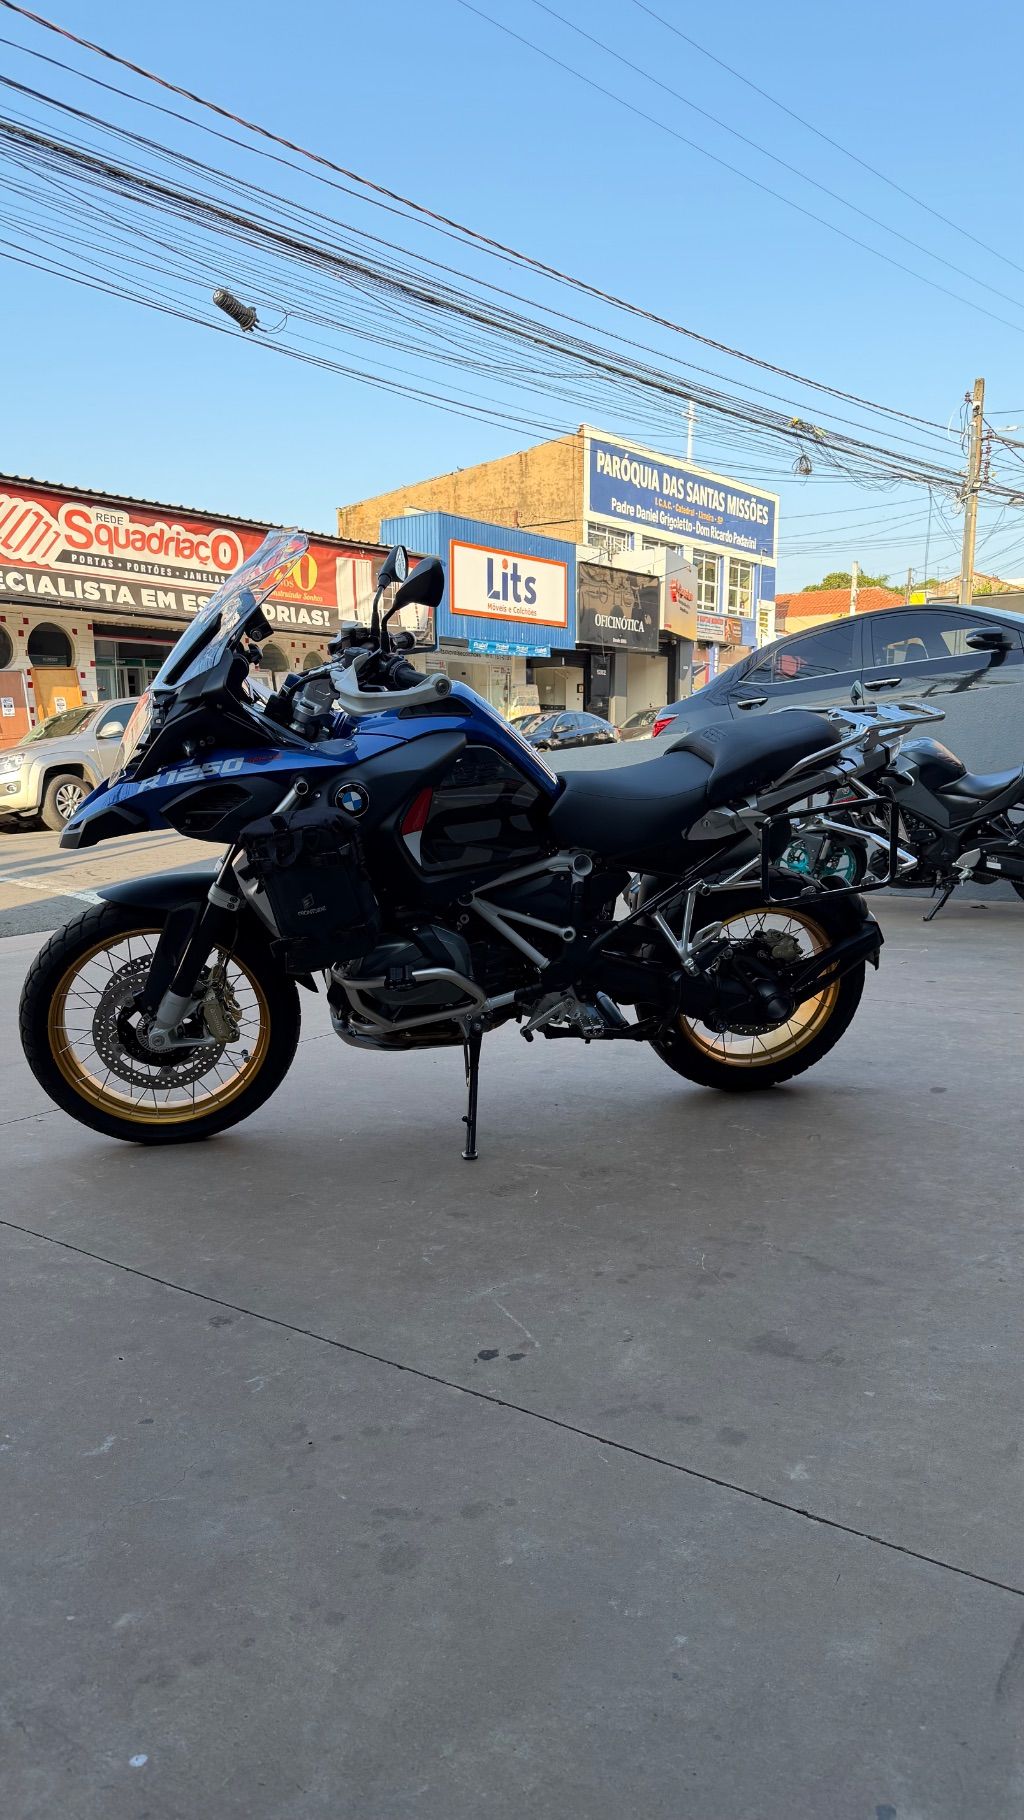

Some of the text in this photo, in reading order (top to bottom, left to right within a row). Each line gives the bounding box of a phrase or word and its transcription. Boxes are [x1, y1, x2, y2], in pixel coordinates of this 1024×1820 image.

[596, 450, 769, 526] PARÓQUIA DAS SANTAS MISSÕES
[96, 512, 124, 526] REDE
[611, 497, 635, 517] Padre
[636, 504, 659, 523] Daniel
[695, 525, 711, 538] Dom
[710, 529, 734, 544] Ricardo
[71, 553, 226, 584] PORTAS PORTÕES JANELAS
[487, 557, 537, 605] Lits
[140, 588, 177, 610] EM
[488, 603, 508, 613] Móveis
[513, 607, 537, 617] Colchões
[595, 612, 644, 633] OFICINÓTICA
[138, 774, 161, 793] R
[166, 757, 244, 785] 1250
